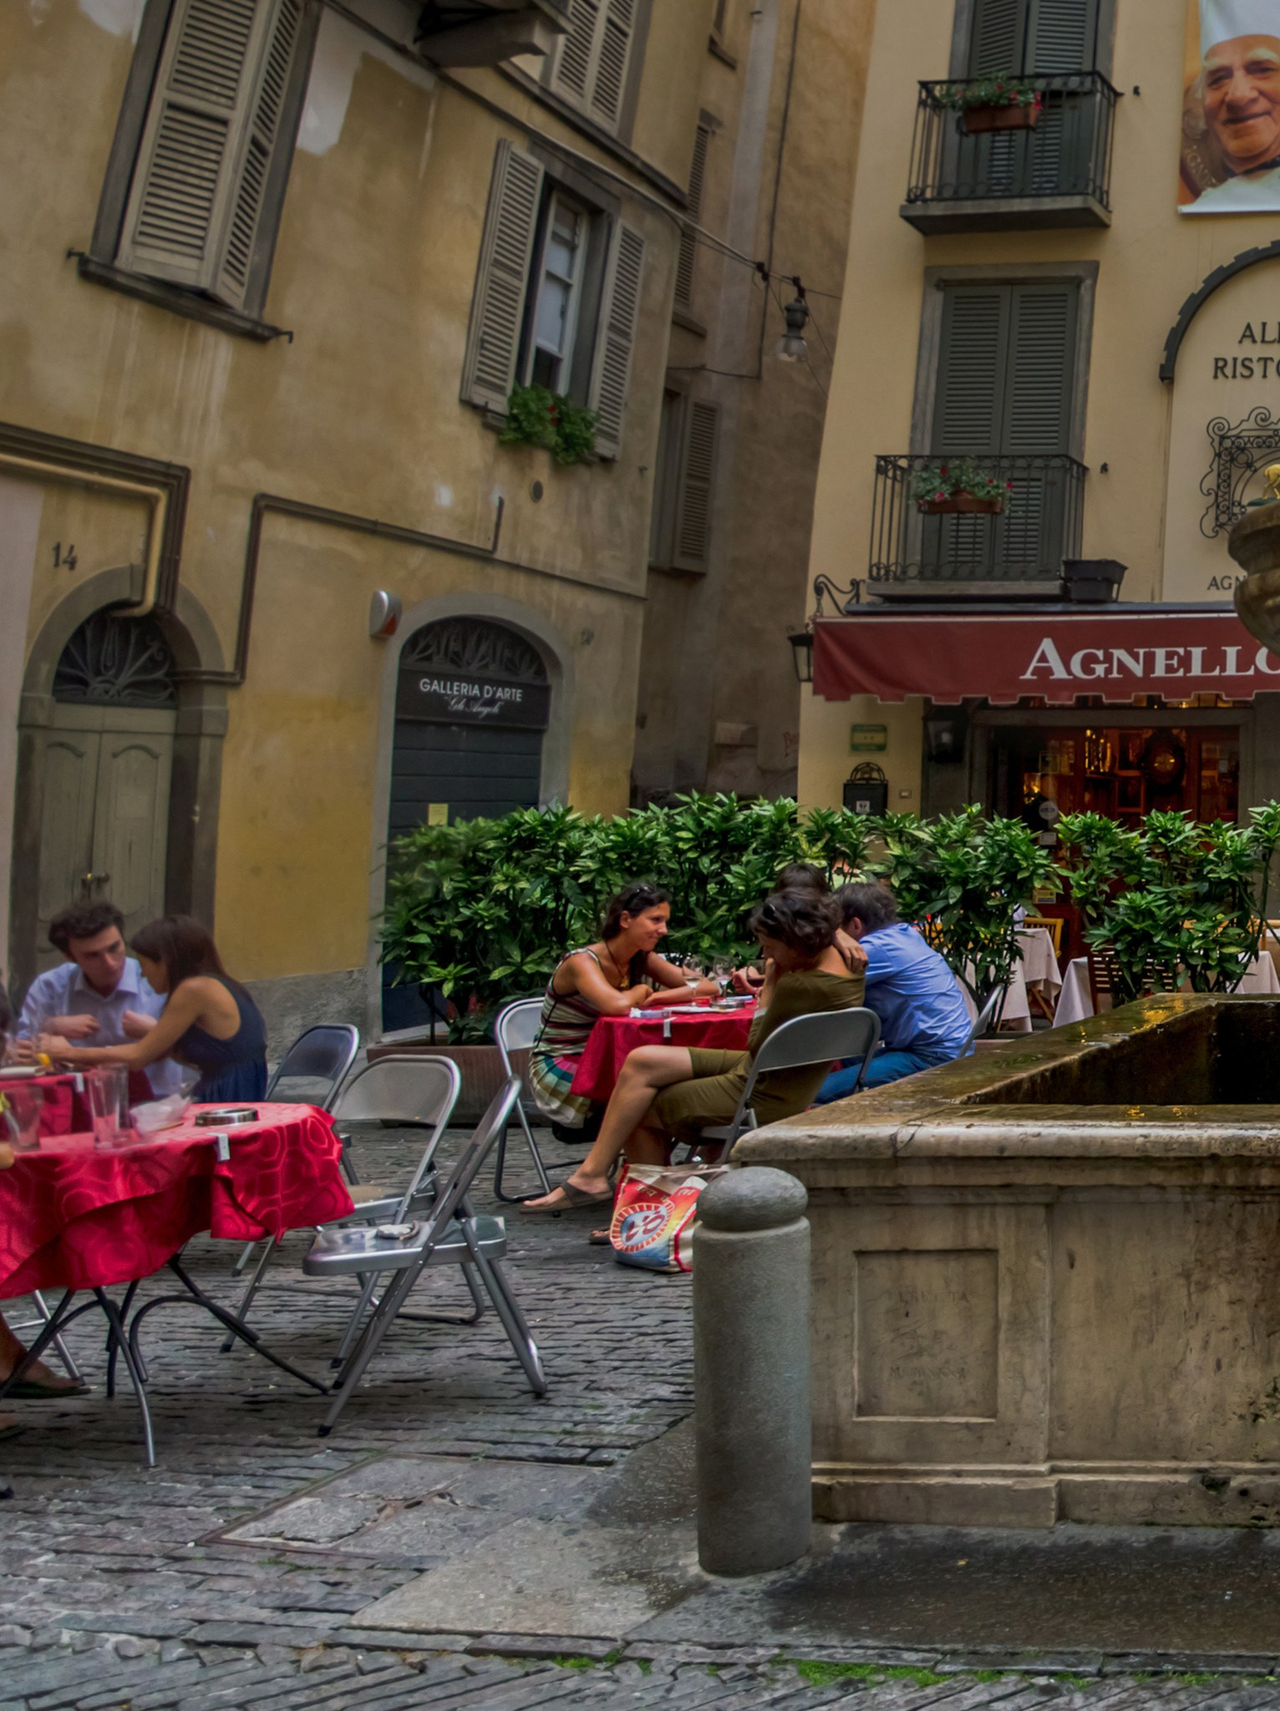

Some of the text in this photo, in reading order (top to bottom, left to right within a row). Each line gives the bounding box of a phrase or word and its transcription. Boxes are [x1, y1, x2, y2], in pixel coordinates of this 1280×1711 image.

[51, 541, 78, 572] 14
[419, 678, 523, 702] GALLERIA D'ARTE
